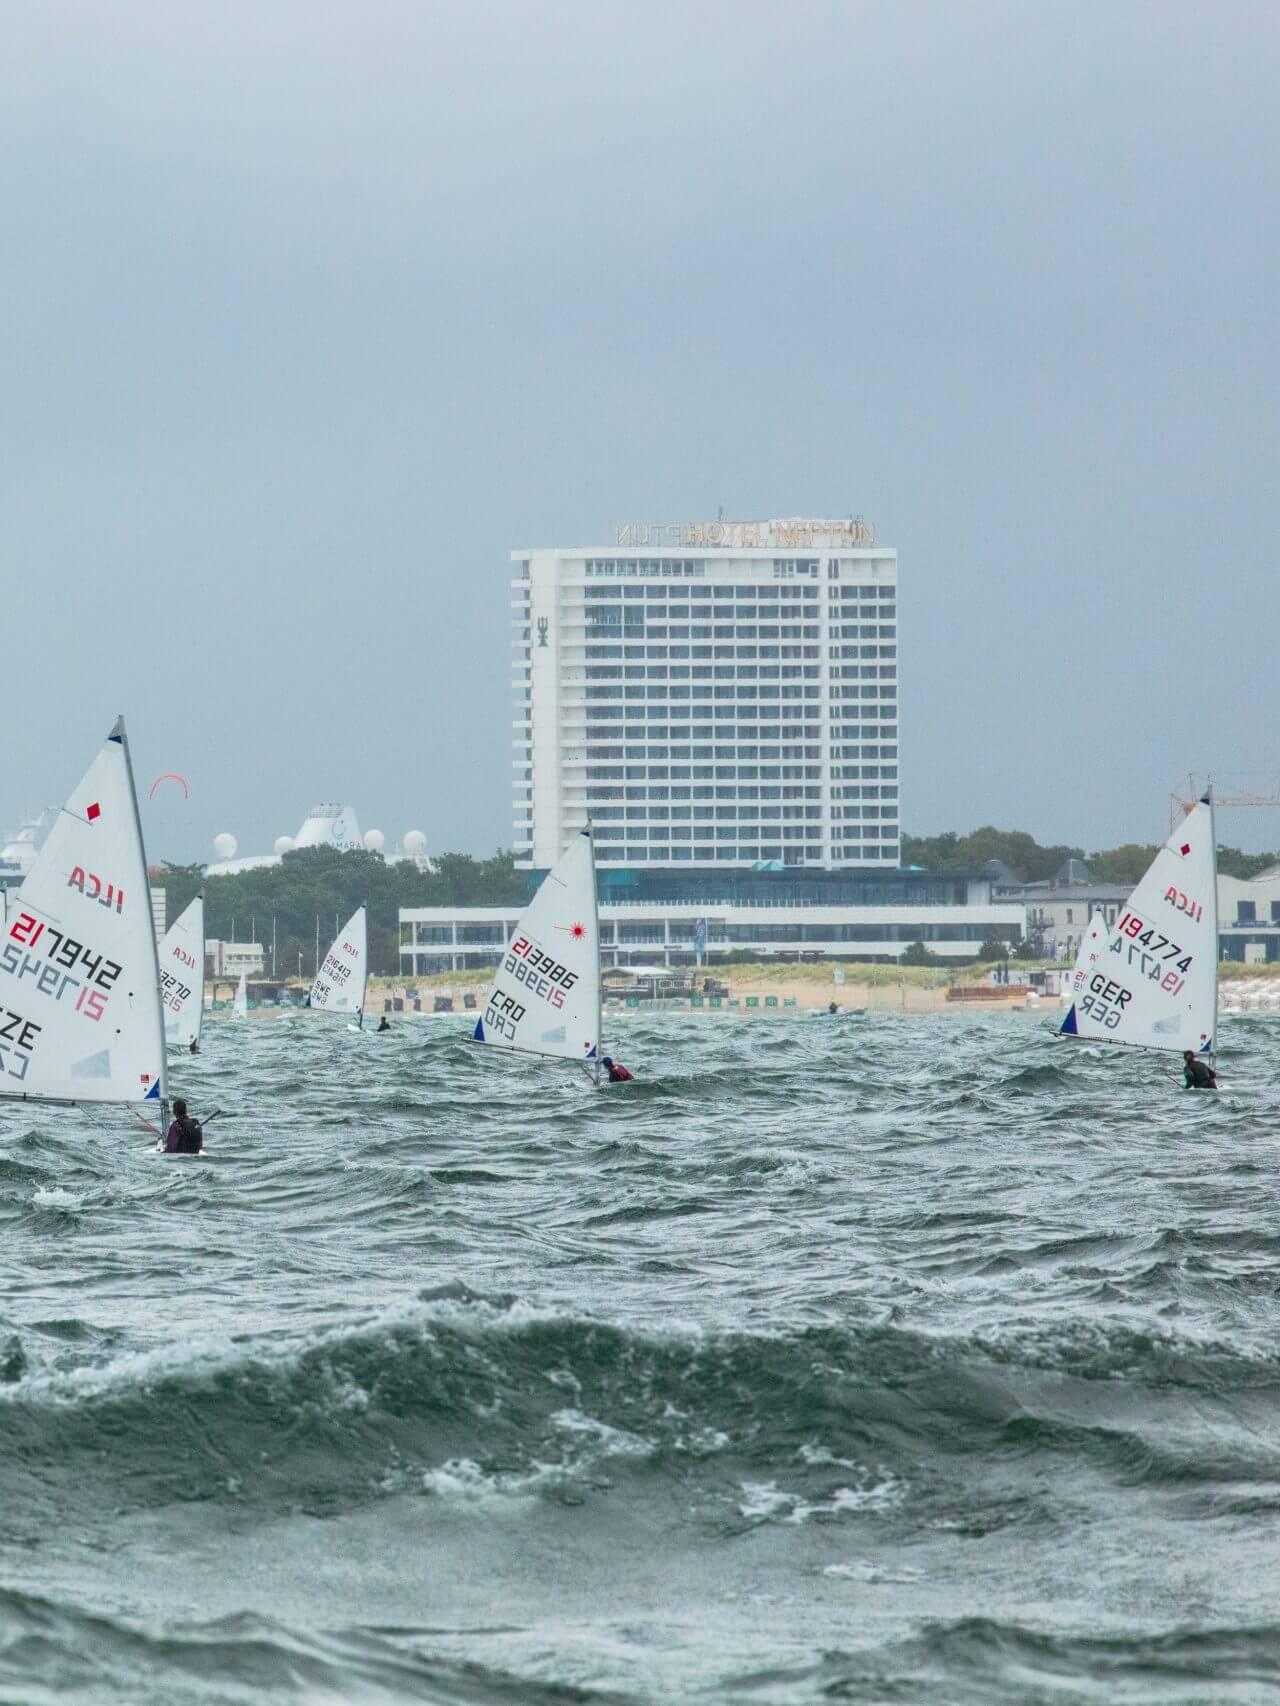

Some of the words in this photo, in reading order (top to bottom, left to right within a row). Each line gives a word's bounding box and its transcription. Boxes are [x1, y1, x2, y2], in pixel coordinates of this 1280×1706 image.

[687, 522, 769, 546] HOTEL
[777, 521, 878, 546] NEPTUN
[10, 912, 123, 990] 217942
[1119, 913, 1193, 974] 194774
[326, 954, 351, 979] 216413
[512, 937, 579, 990] 213986
[160, 968, 191, 1000] 3270
[316, 980, 331, 996] SWE
[1090, 974, 1132, 1010] GER
[490, 990, 526, 1022] CRO
